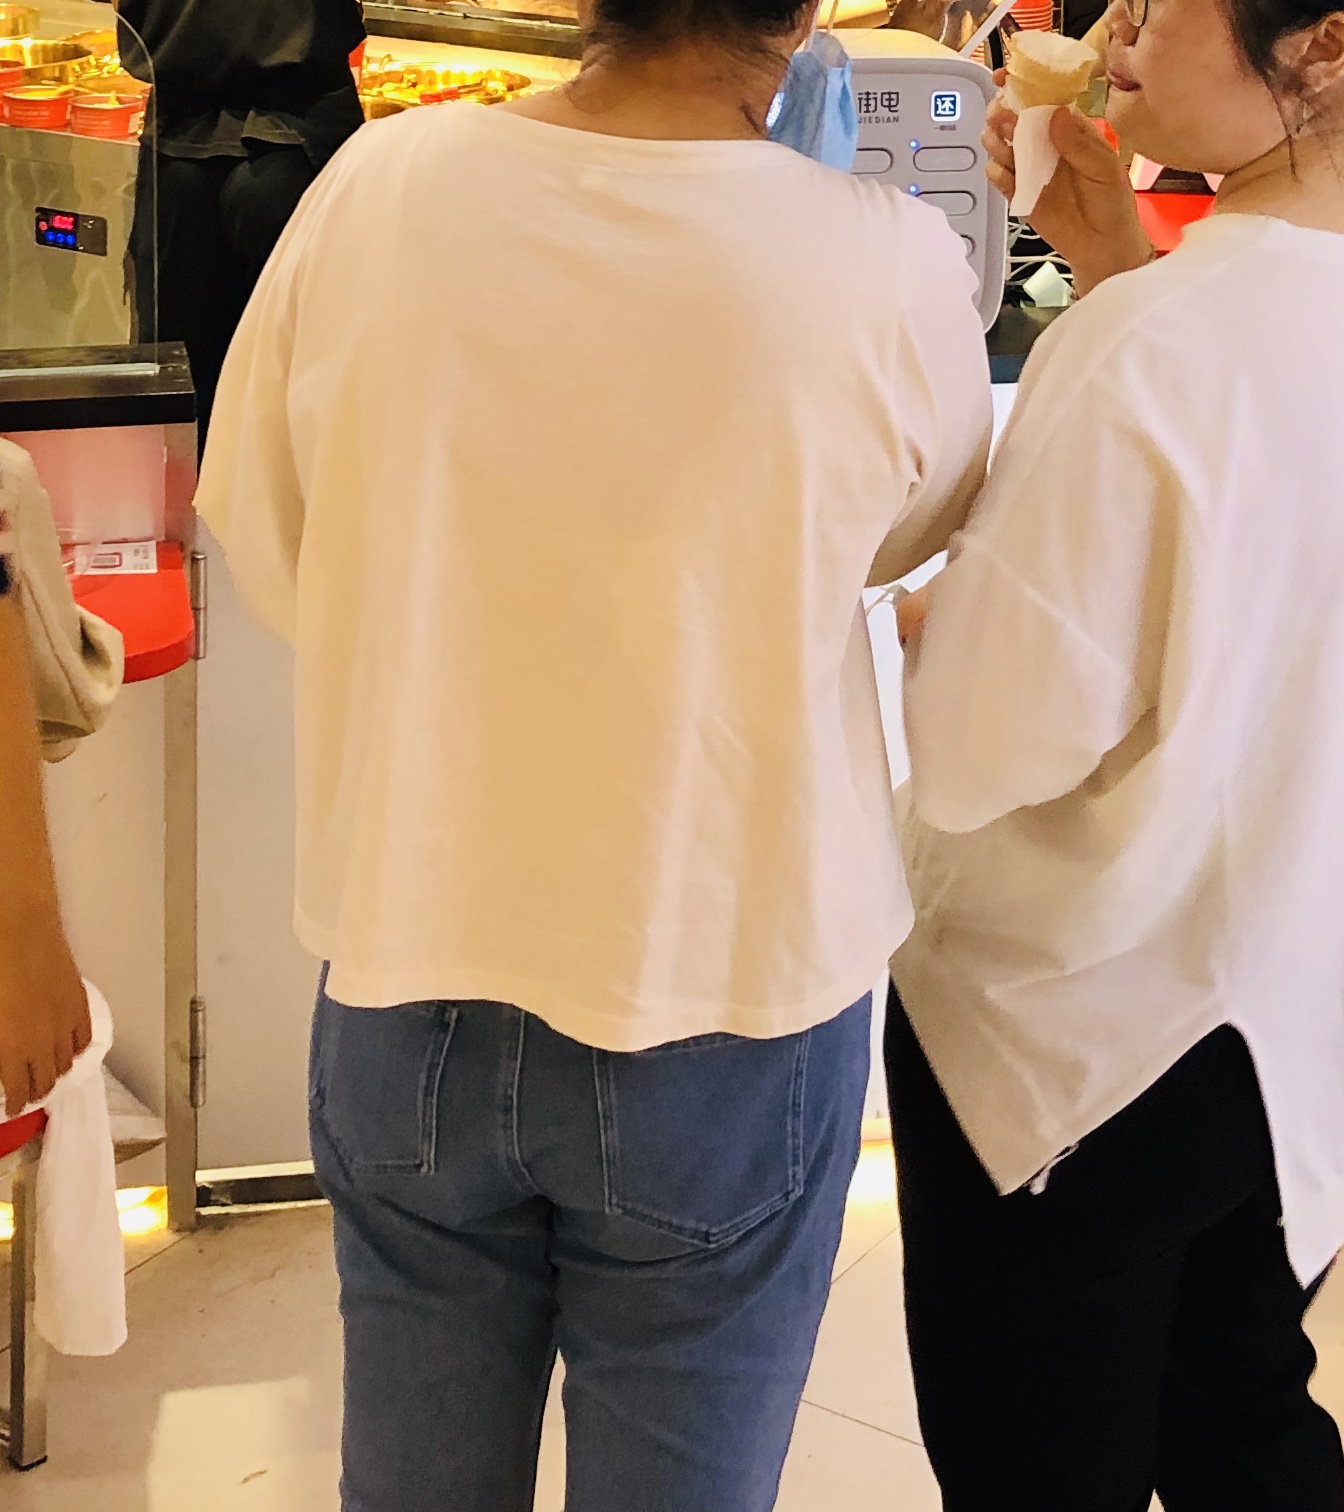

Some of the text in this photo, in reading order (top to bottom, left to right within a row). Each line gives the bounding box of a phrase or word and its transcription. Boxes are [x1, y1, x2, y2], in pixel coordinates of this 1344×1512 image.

[857, 90, 901, 114] 街电
[935, 96, 955, 115] 还
[857, 115, 900, 125] JIEDIAN
